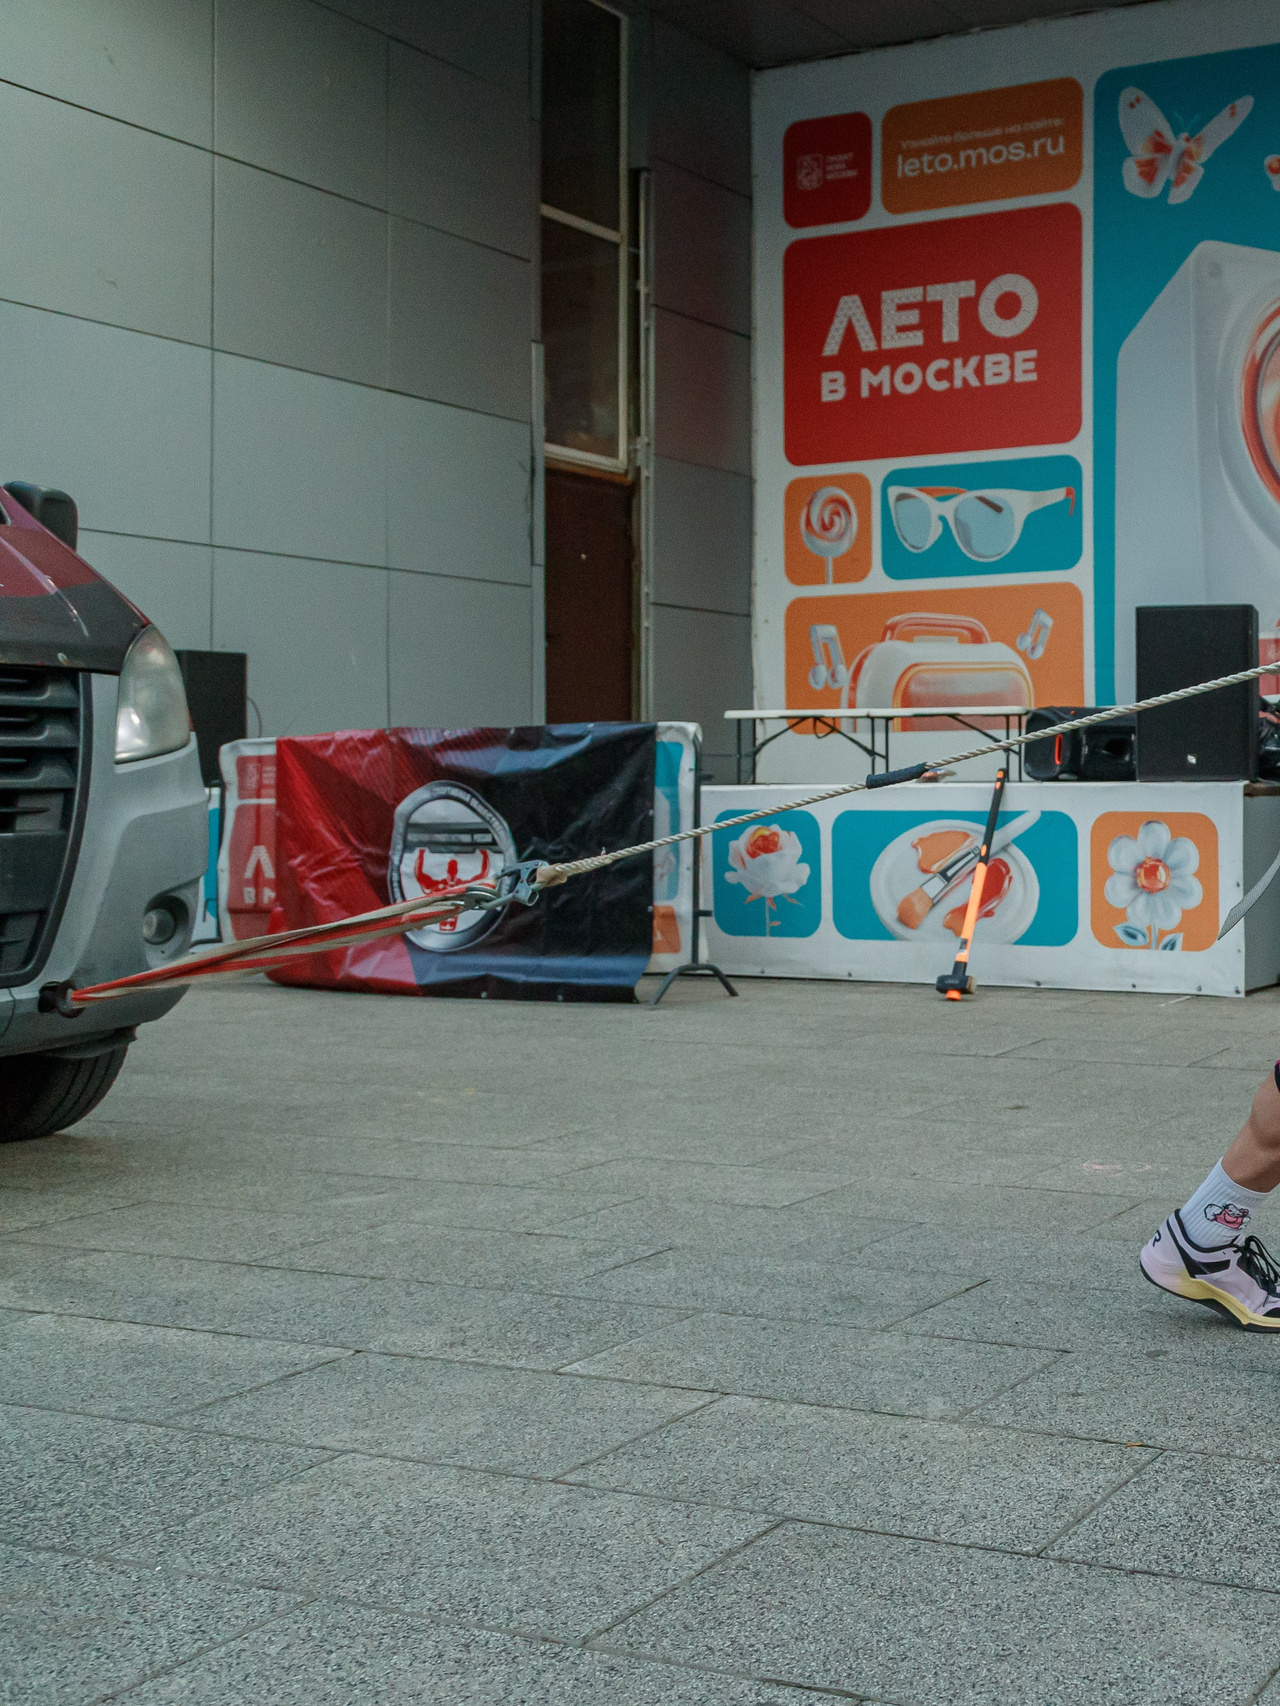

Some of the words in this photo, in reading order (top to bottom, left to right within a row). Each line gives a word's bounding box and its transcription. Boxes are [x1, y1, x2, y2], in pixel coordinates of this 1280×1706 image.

[897, 135, 1064, 178] leto.mos.ru
[821, 273, 1039, 356] ЛЕТО
[820, 370, 846, 402] В
[860, 349, 1038, 398] МОСКВЕ
